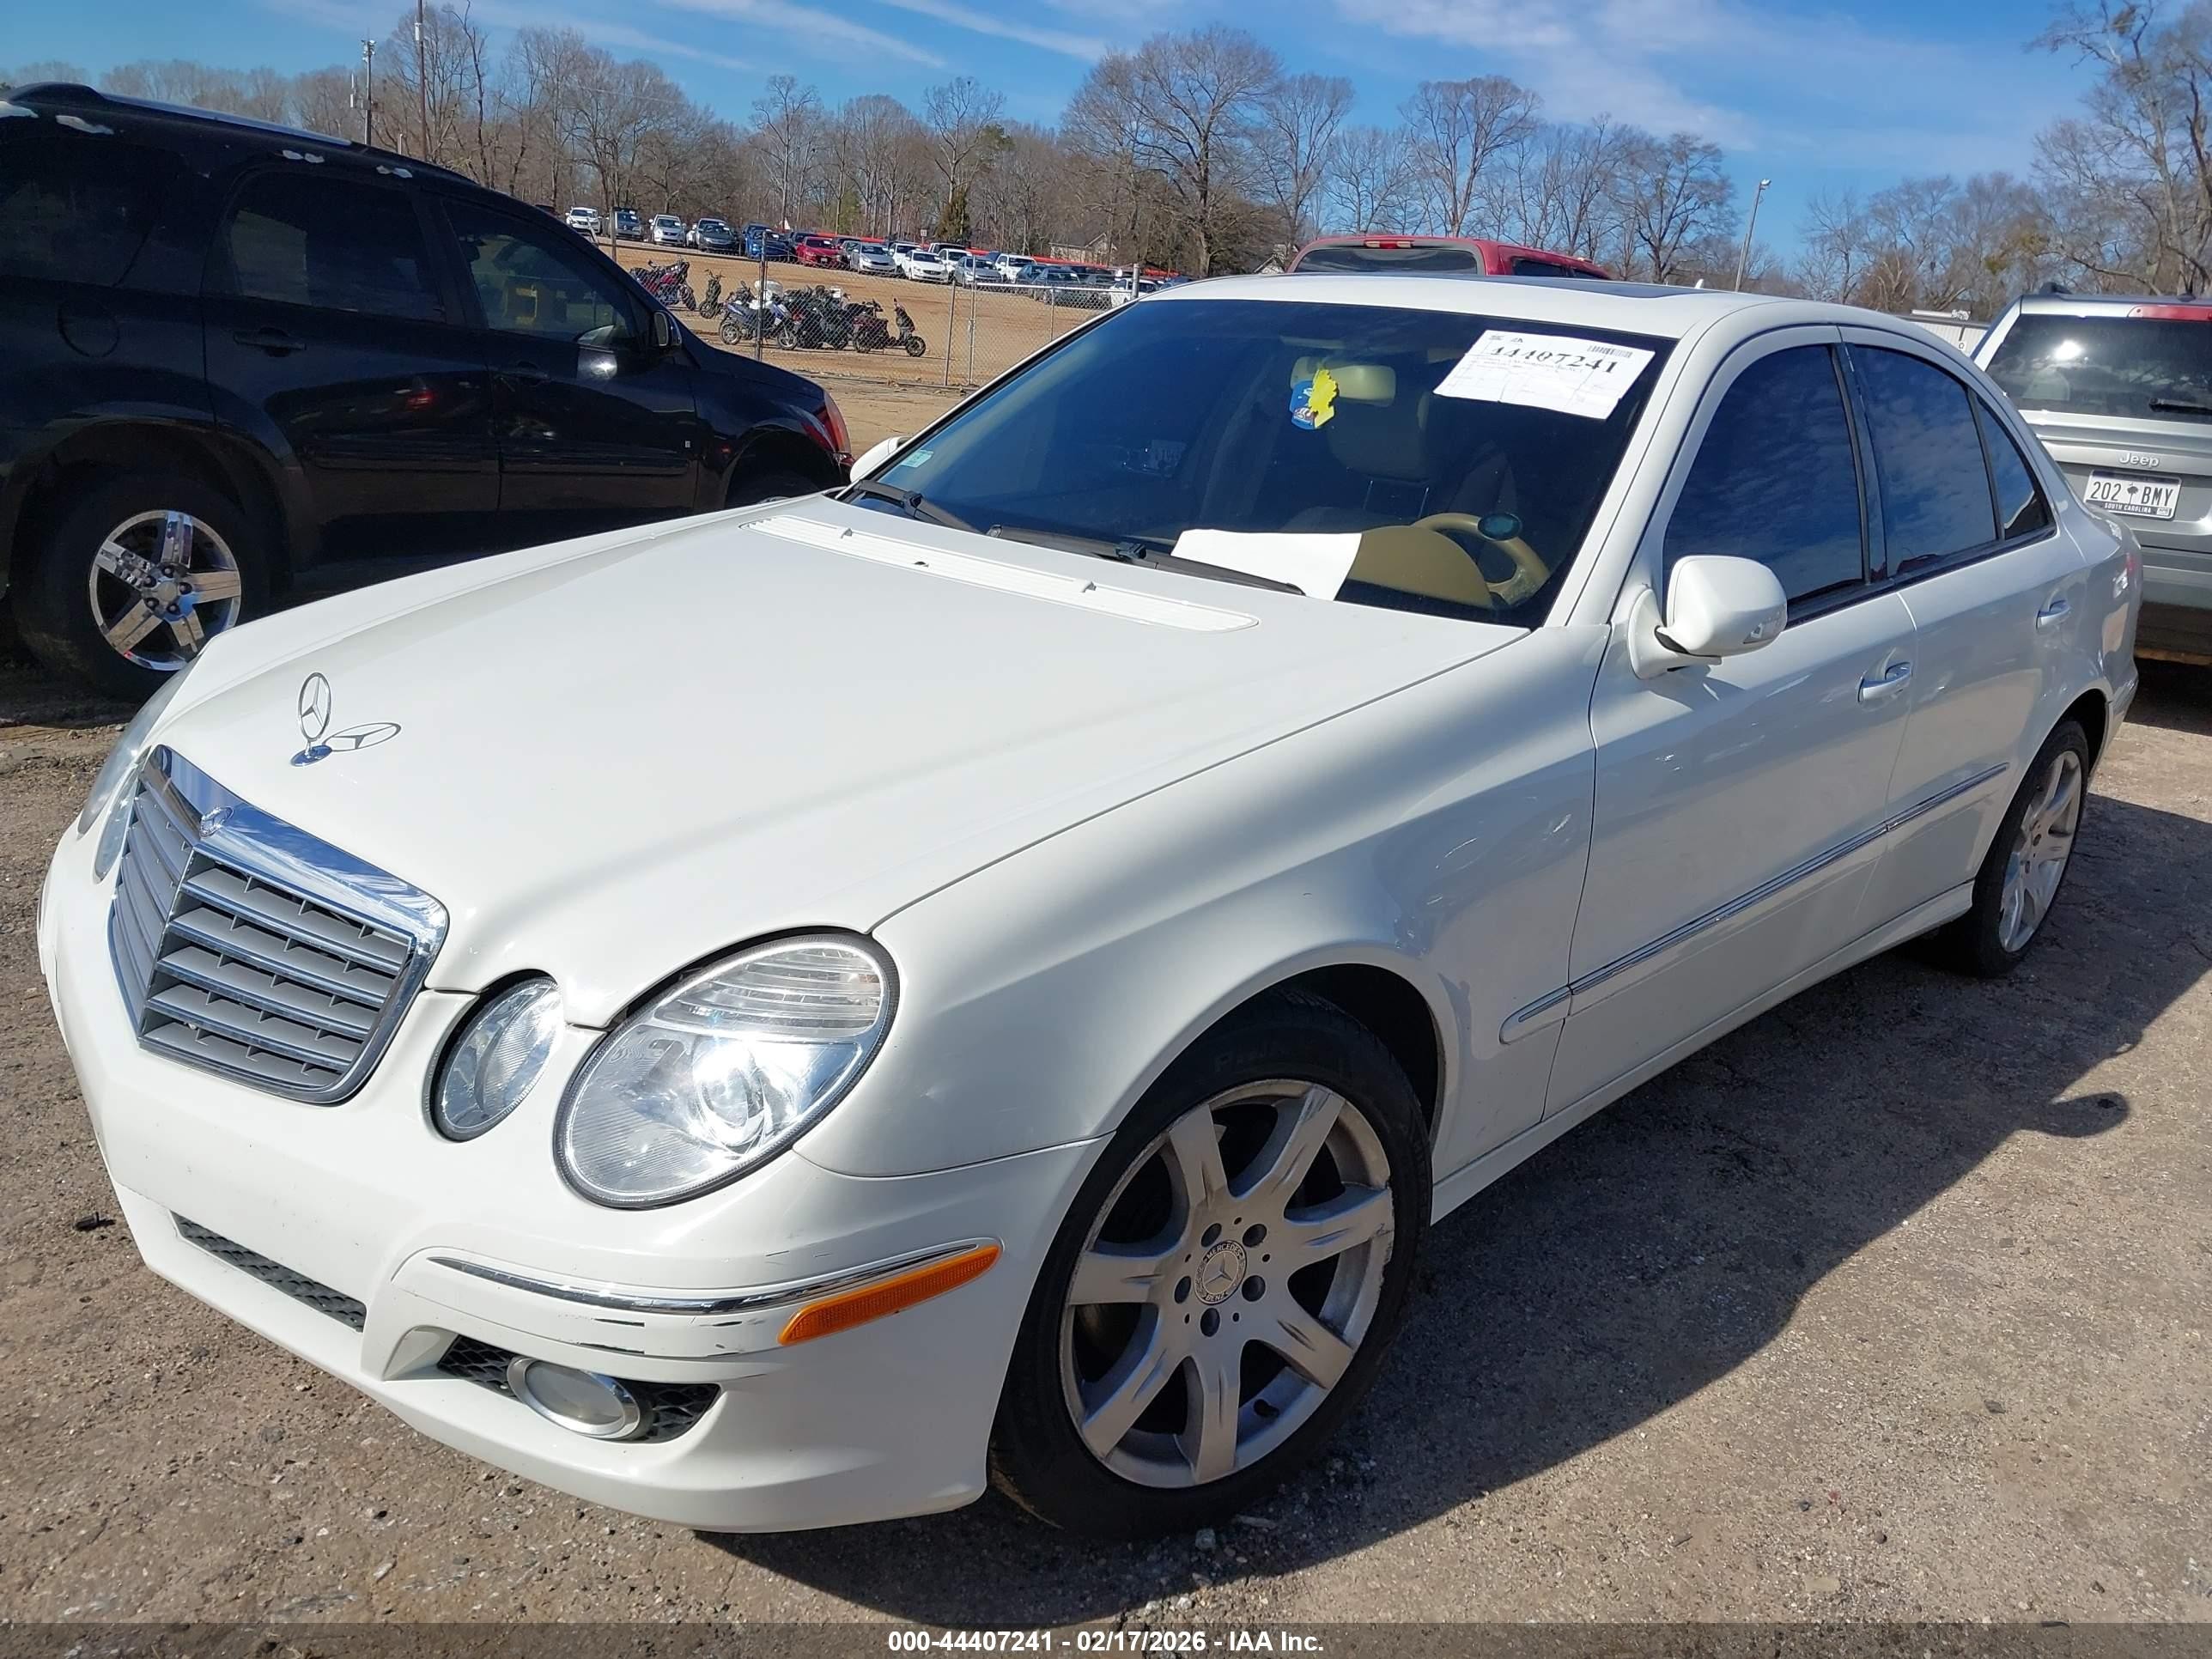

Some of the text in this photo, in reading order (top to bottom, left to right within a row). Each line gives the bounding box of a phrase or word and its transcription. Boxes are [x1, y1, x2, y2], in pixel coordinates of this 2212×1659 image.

[2119, 452, 2160, 468] Jeep
[2090, 481, 2173, 507] 202 BMY
[2124, 504, 2152, 514] CAROLINA
[1207, 1243, 1242, 1258] MERCEDES
